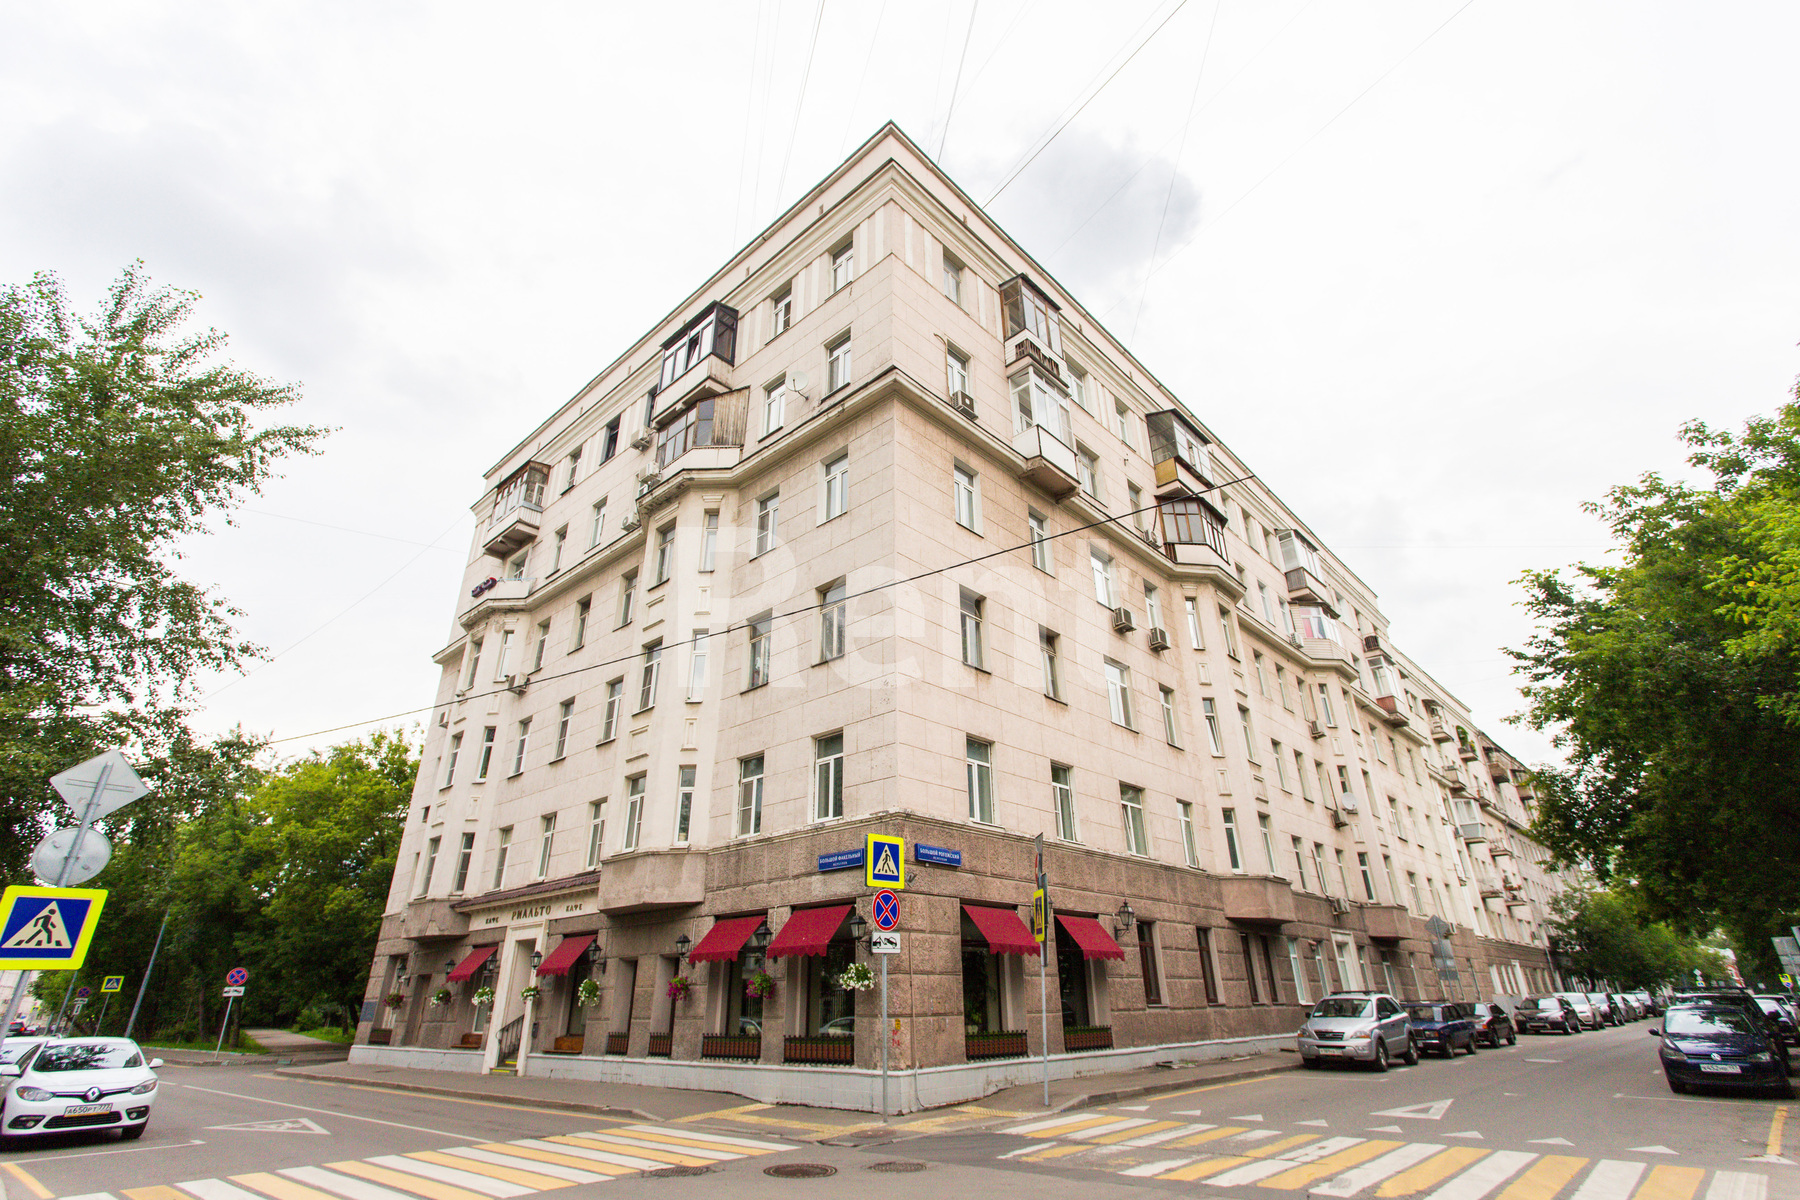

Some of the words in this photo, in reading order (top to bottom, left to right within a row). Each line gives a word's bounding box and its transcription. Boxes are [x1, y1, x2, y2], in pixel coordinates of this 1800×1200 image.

[485, 916, 499, 924] КАФЕ
[511, 905, 552, 921] РИАЛЬТО
[565, 903, 583, 912] КАФЕ
